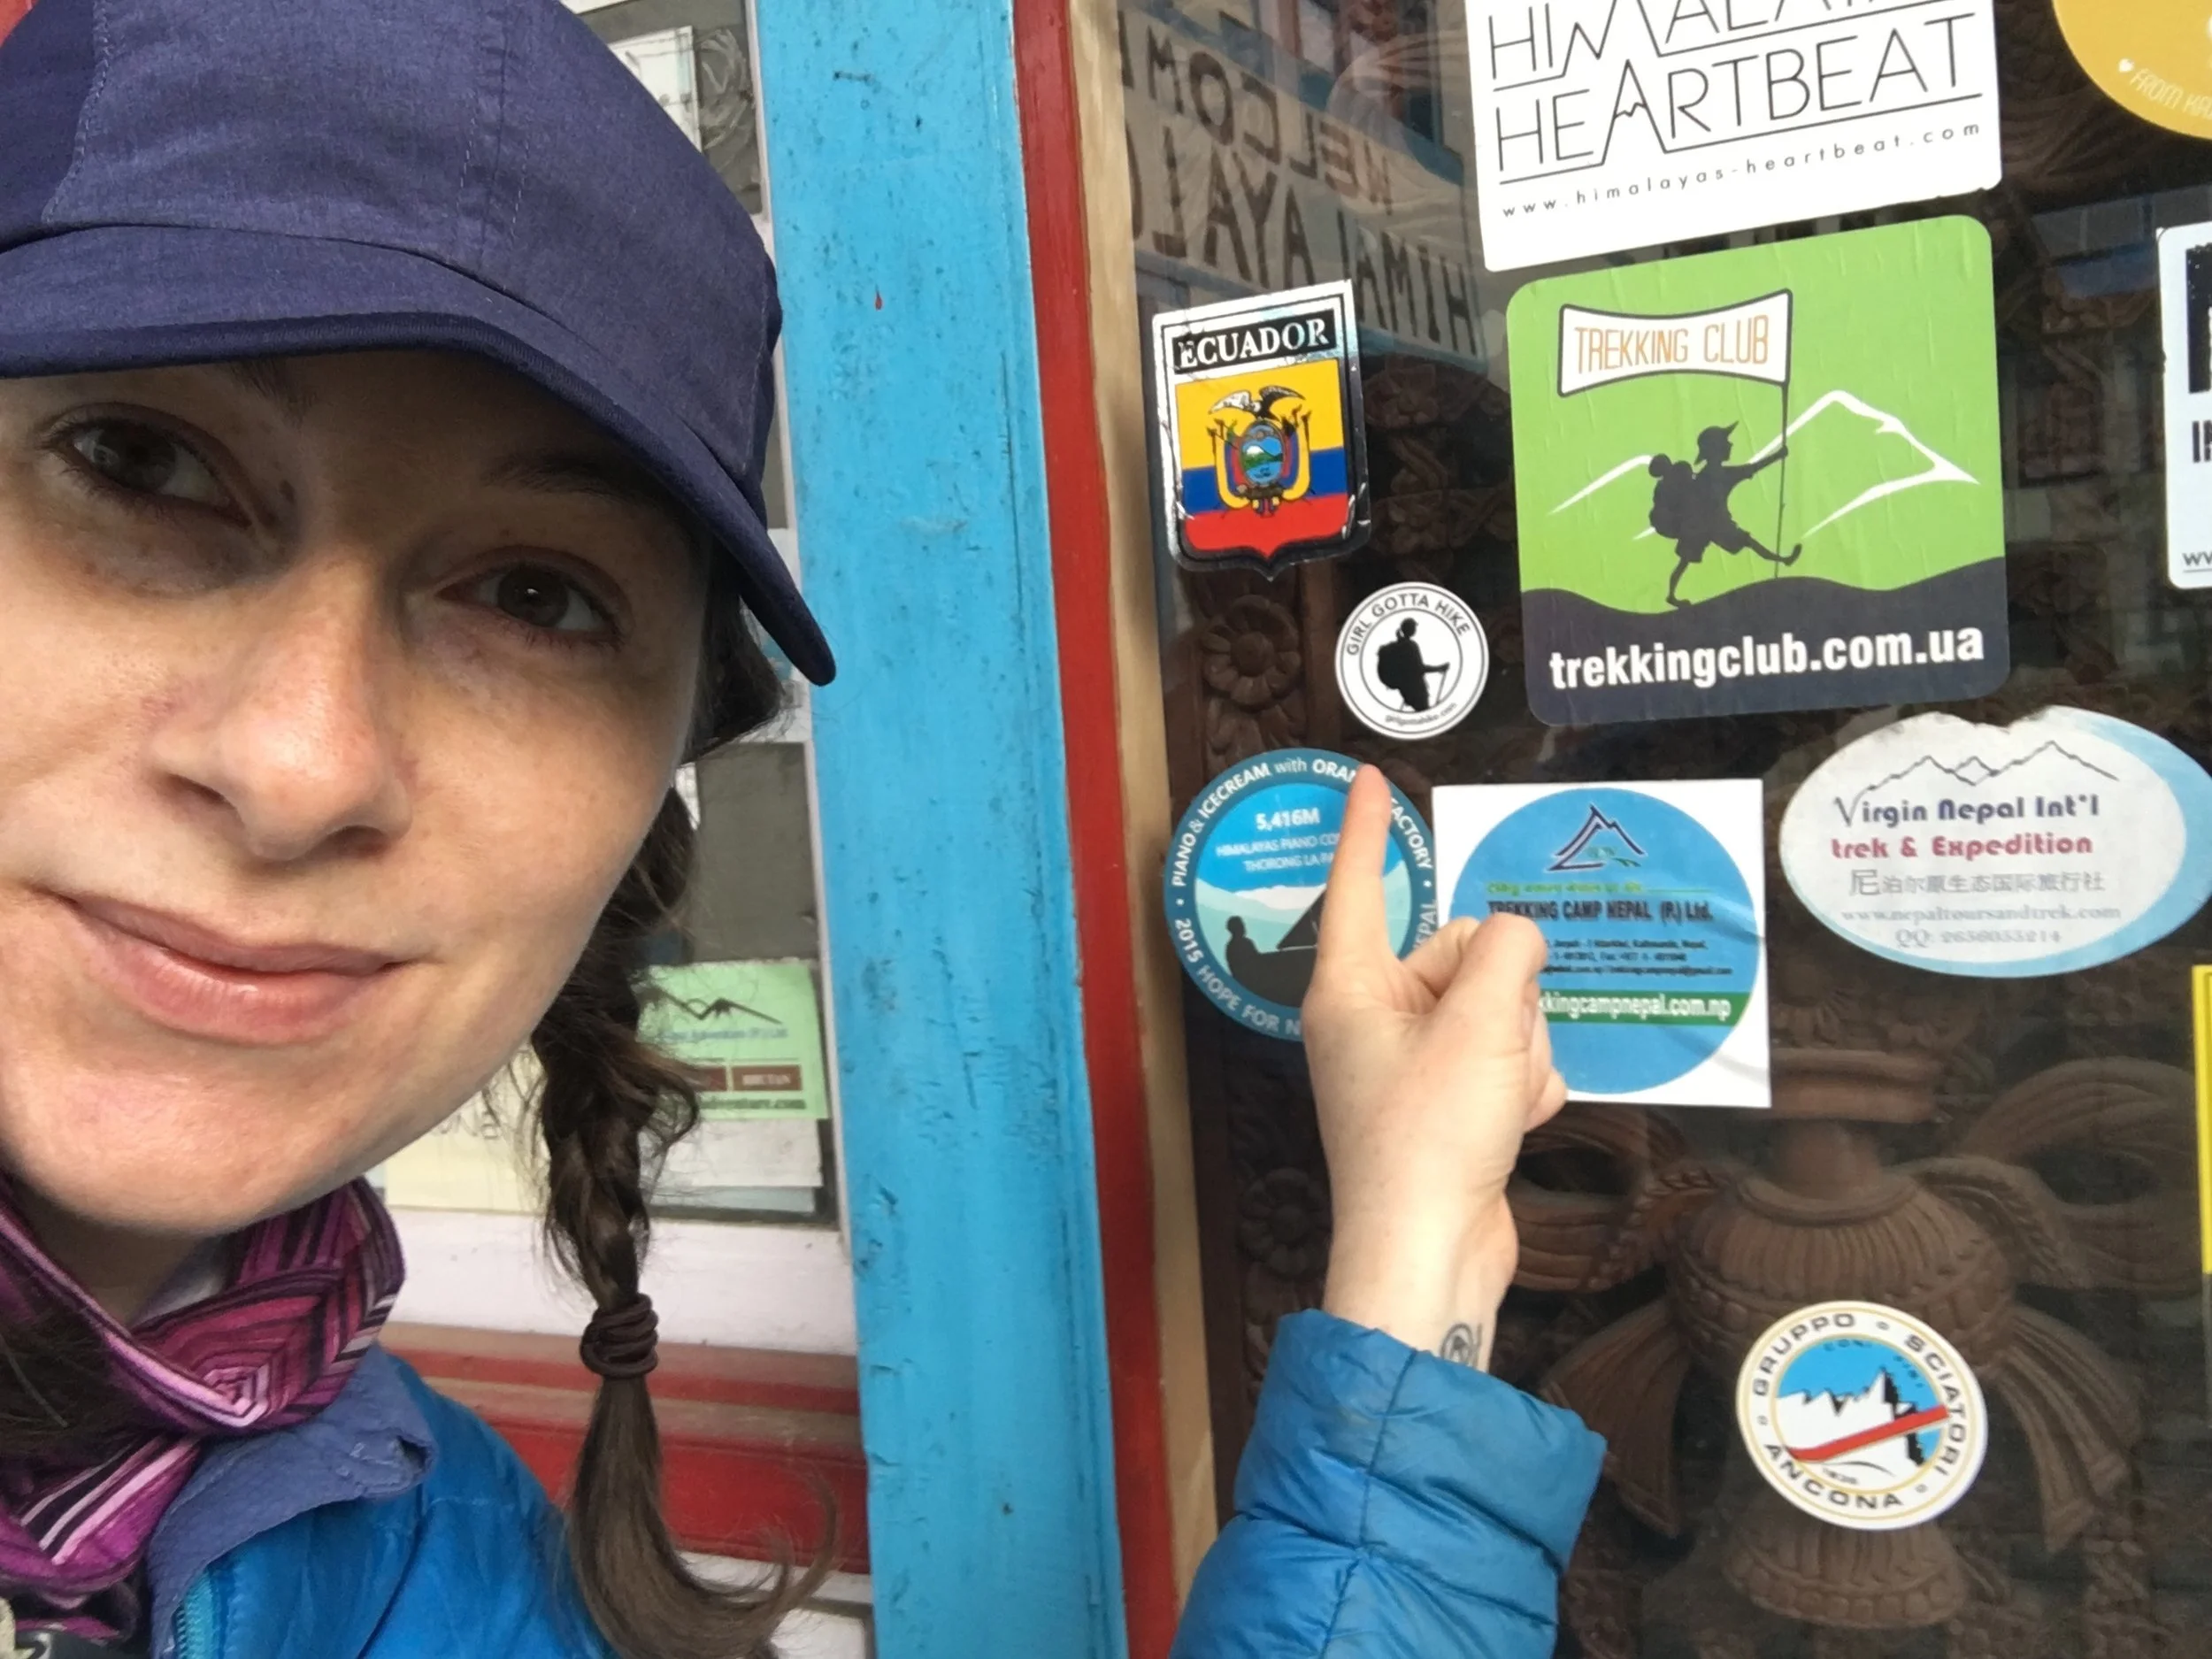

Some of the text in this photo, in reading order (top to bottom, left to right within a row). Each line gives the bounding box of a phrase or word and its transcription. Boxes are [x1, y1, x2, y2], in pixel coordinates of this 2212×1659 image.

[1496, 12, 1976, 172] HEARTBEAT
[1503, 122, 1981, 218] www.himalayas-heartbeat.com
[1179, 319, 1329, 368] ECUADOR
[1575, 314, 1769, 374] TREKKING CLUB
[1347, 593, 1471, 655] GIRL GOTTA HIKE
[1550, 626, 1984, 689] trekkingclub.com.ua
[1171, 833, 1196, 887] PIANO
[1192, 819, 1203, 833] &
[1199, 762, 1271, 819] ICECREAM
[1274, 757, 1308, 773] with
[1255, 807, 1321, 832] 5,416M
[1834, 794, 2100, 828] Virgin Nepal Int'l
[1216, 839, 1279, 856] HIMALAYAS
[1280, 835, 1317, 850] PIANO
[1831, 832, 2093, 861] trek & Expedition
[1563, 900, 1601, 920] CAMP
[1606, 900, 1653, 921] NEPAL
[1175, 918, 1204, 963] 2015
[1196, 964, 1242, 1011] HOPE
[1241, 1003, 1280, 1033] FOR
[1753, 1312, 1967, 1477] GRUPPO SCIATORI
[1763, 1440, 1904, 1509] ANCONA
